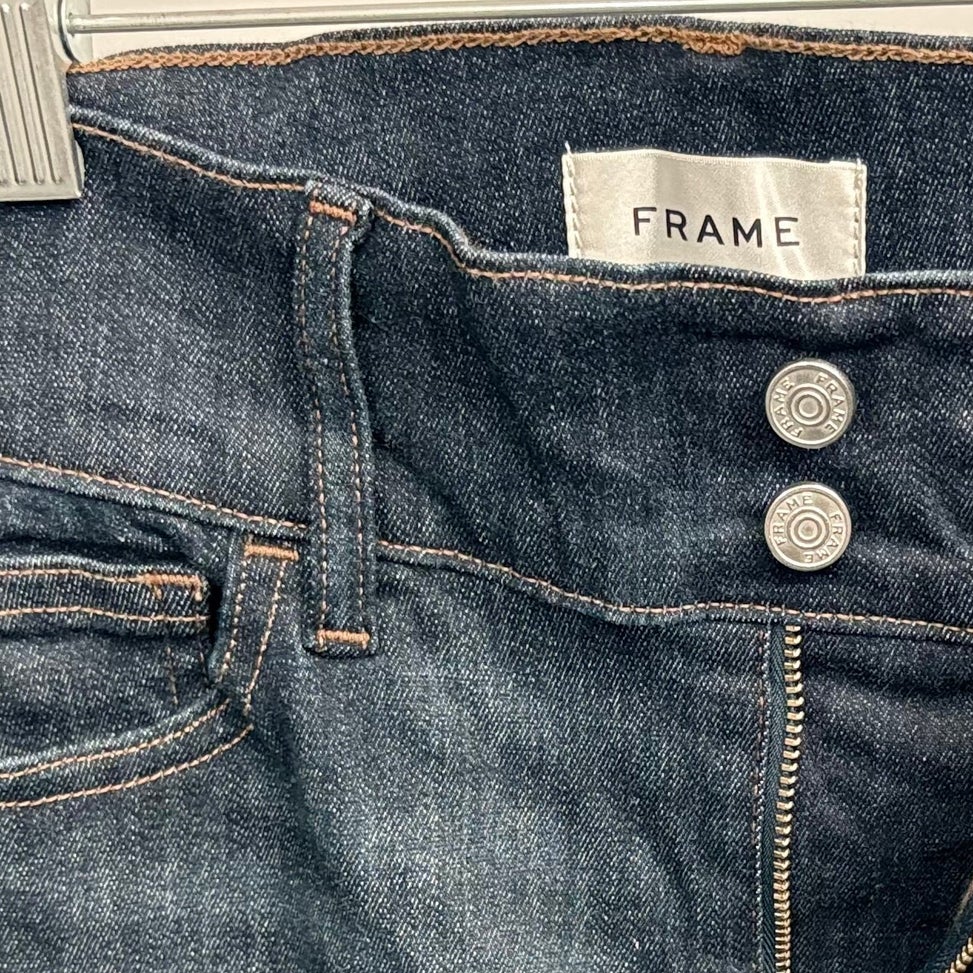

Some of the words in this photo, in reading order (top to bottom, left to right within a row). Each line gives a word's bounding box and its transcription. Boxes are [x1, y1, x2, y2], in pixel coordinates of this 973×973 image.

[633, 206, 800, 248] FRAME
[773, 377, 804, 438] FRAME
[815, 373, 846, 435] FRAME
[773, 495, 814, 546] FRAME
[804, 513, 843, 563] FRAME
